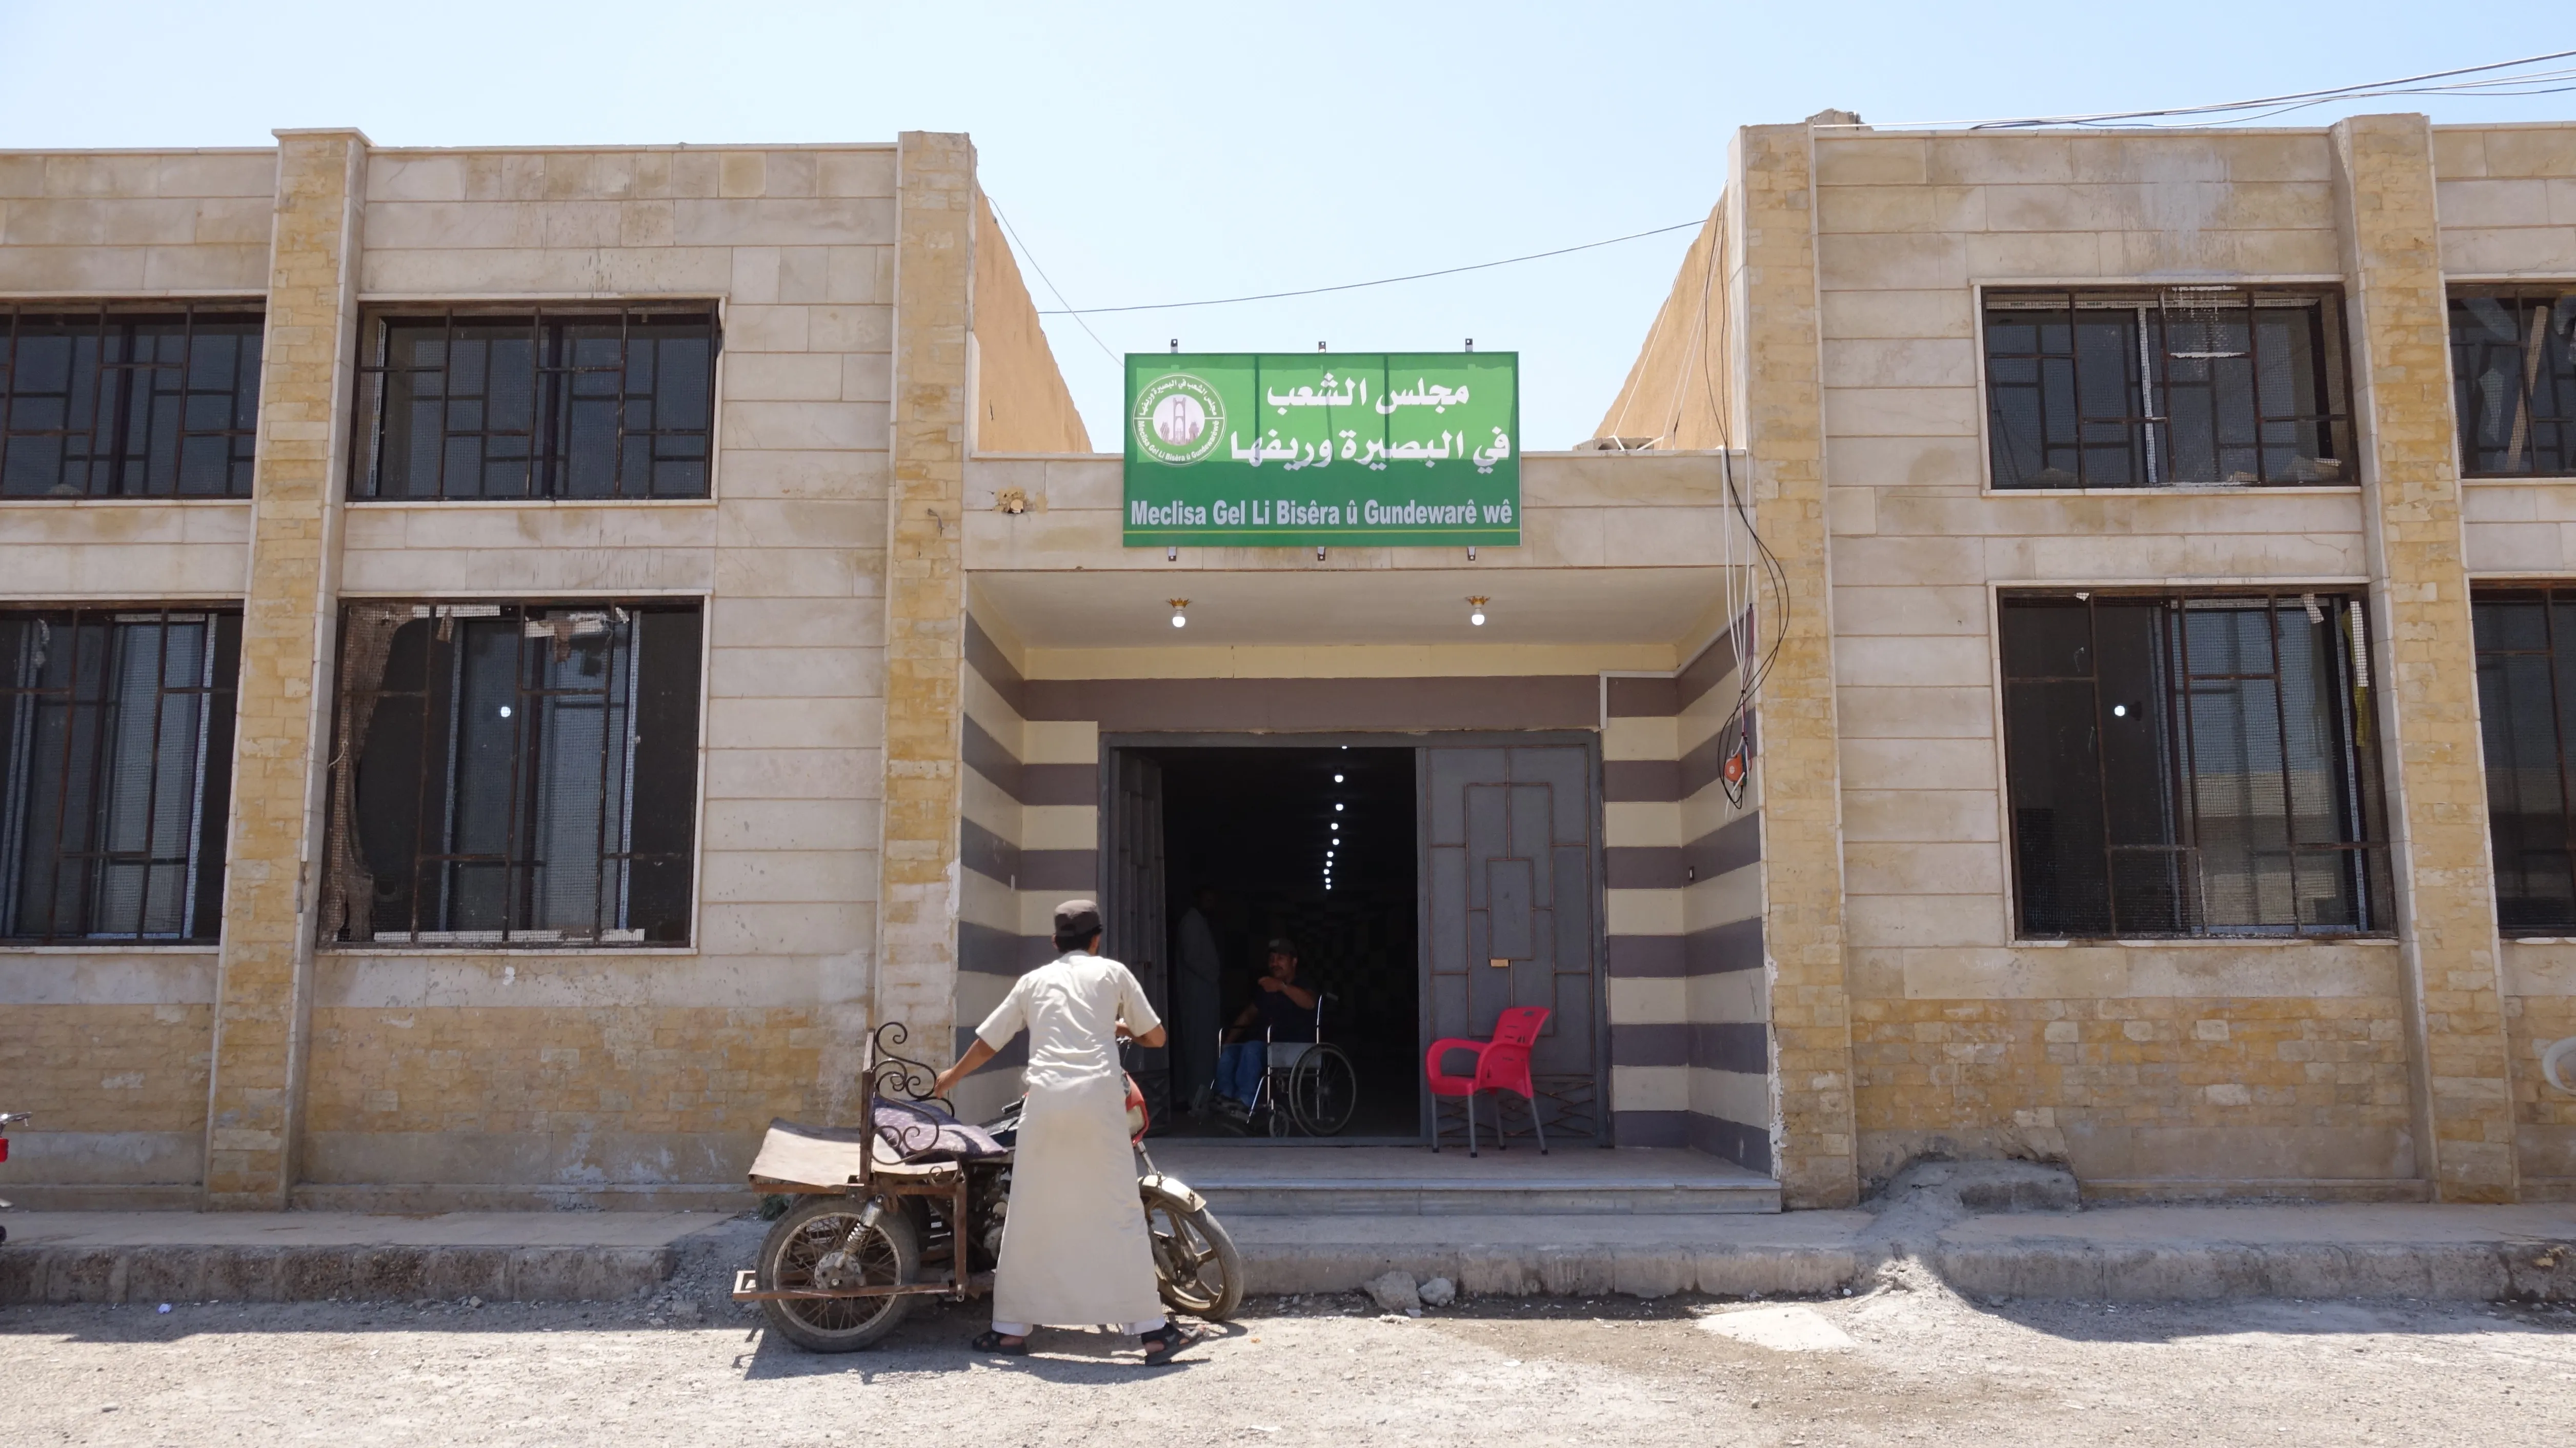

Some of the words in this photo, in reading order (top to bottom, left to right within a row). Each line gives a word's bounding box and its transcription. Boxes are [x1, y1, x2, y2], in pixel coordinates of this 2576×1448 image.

[1151, 379, 1177, 394] البصيرة
[1178, 378, 1186, 390] في
[1187, 383, 1208, 396] الشعب
[1267, 372, 1367, 415] الشعب
[1376, 377, 1470, 414] مجلس
[1139, 393, 1155, 416] وريفها
[1203, 396, 1217, 416] مجلس
[1138, 420, 1150, 447] Meclisa
[1149, 445, 1159, 455] Gel
[1231, 429, 1333, 471] وريفها
[1339, 429, 1464, 471] البصيرة
[1473, 426, 1511, 474] في
[1131, 500, 1206, 525] Meclisa
[1213, 500, 1245, 525] Gel
[1253, 500, 1270, 525] Li
[1277, 499, 1340, 525] Bisêra
[1346, 499, 1358, 525] û
[1364, 499, 1477, 525] Gundewarê
[1482, 498, 1512, 524] wê
